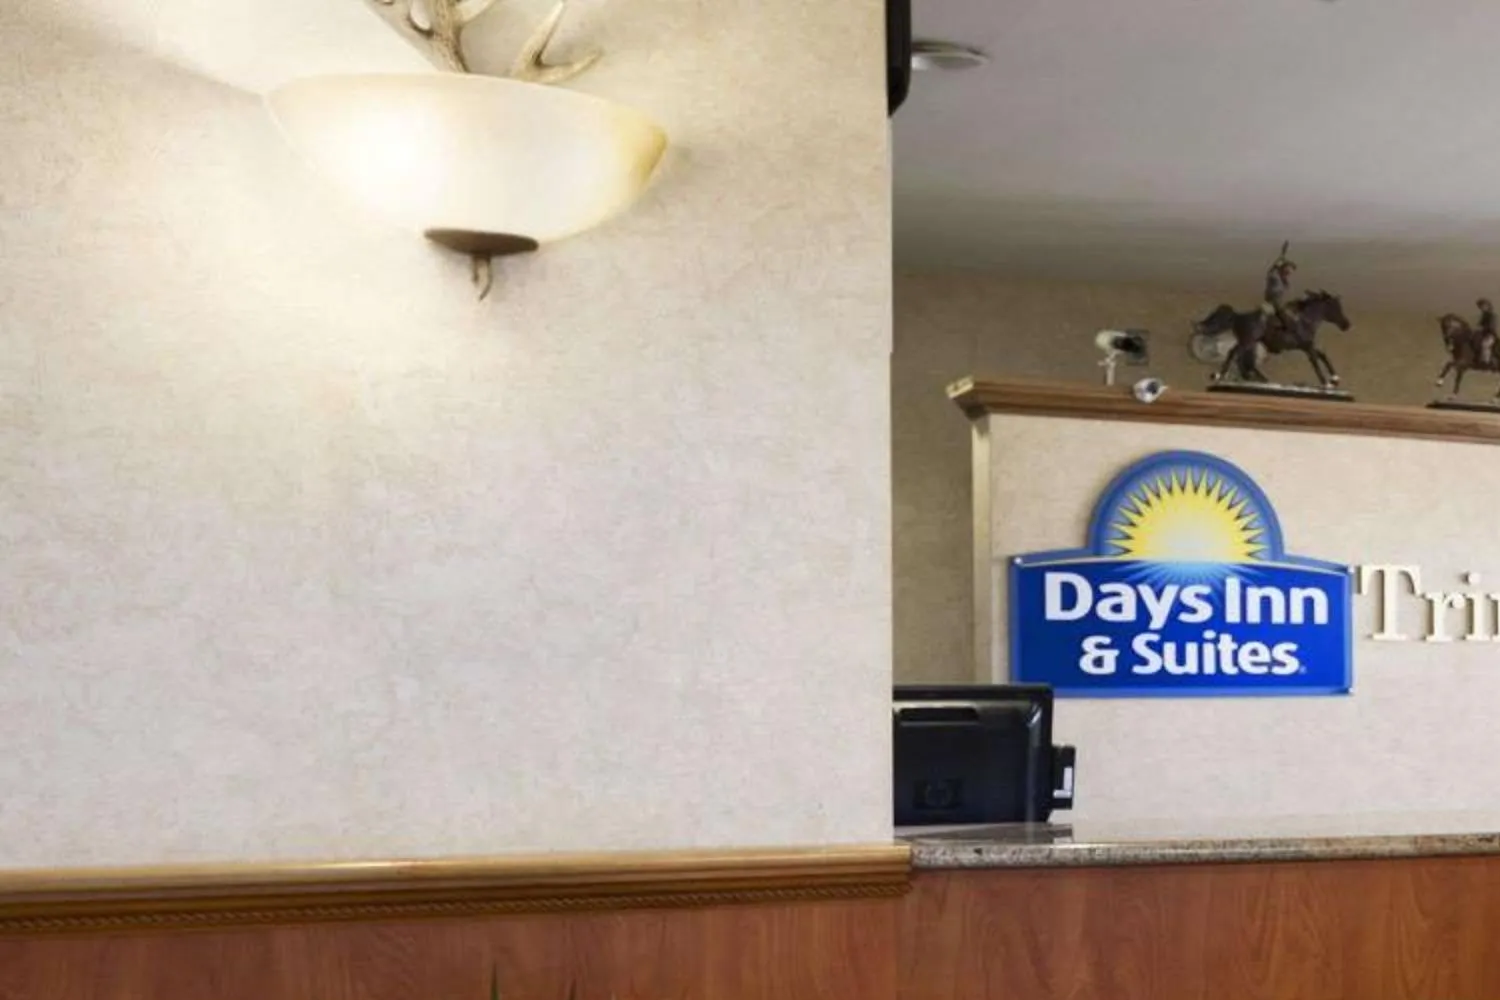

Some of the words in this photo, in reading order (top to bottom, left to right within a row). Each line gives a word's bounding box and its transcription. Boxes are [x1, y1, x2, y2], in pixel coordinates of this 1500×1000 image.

[1044, 573, 1215, 627] Days
[1225, 577, 1331, 625] Inn
[1079, 636, 1119, 675] &
[1132, 630, 1299, 676] Suites
